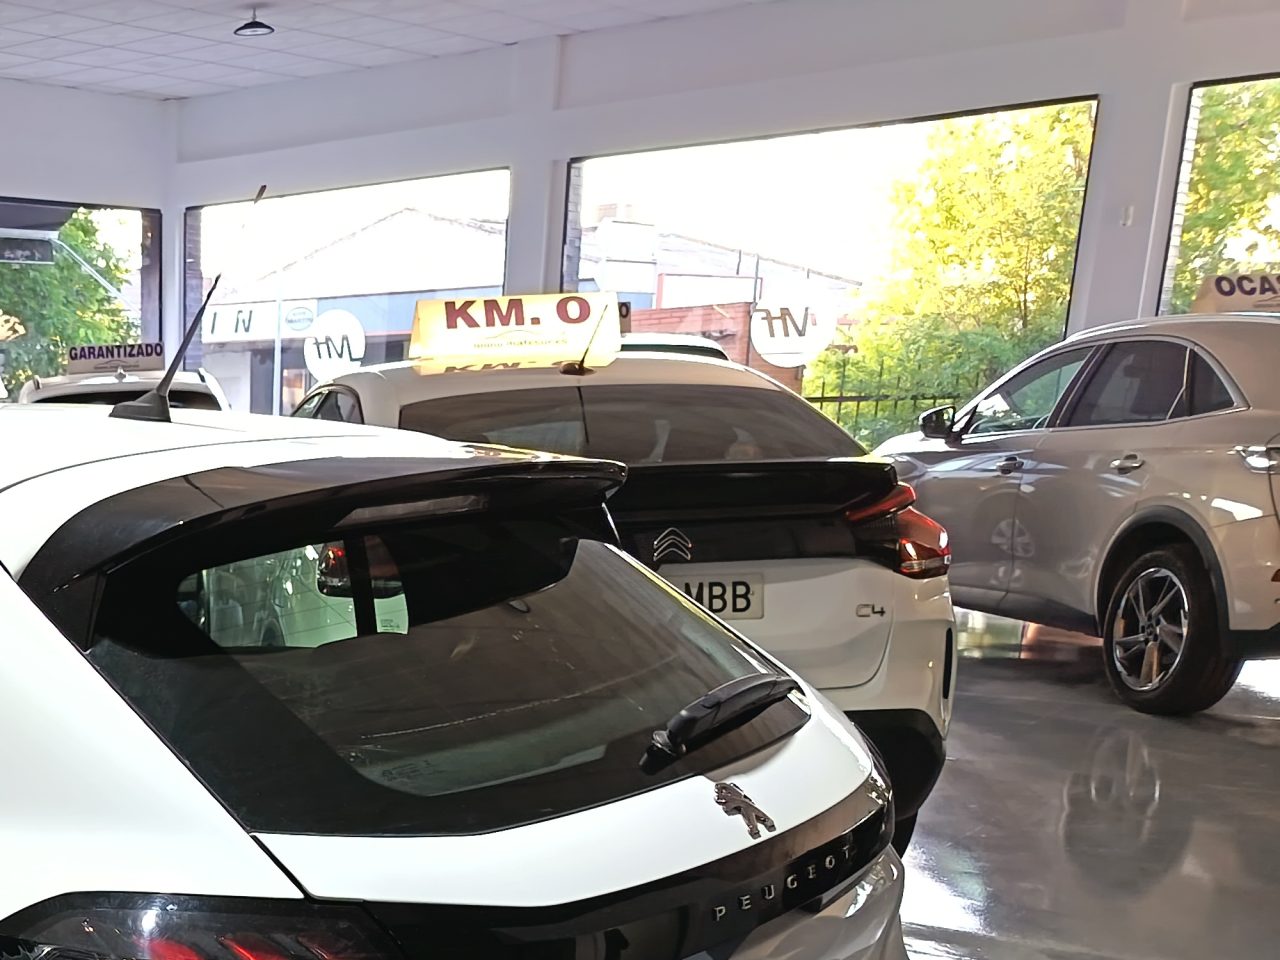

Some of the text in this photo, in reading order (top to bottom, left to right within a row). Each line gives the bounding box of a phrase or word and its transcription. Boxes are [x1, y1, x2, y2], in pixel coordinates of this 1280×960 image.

[1214, 275, 1280, 297] OCA
[444, 298, 541, 329] KM.
[69, 342, 163, 361] GARANTIZADO
[713, 845, 850, 922] PEUGEOT
